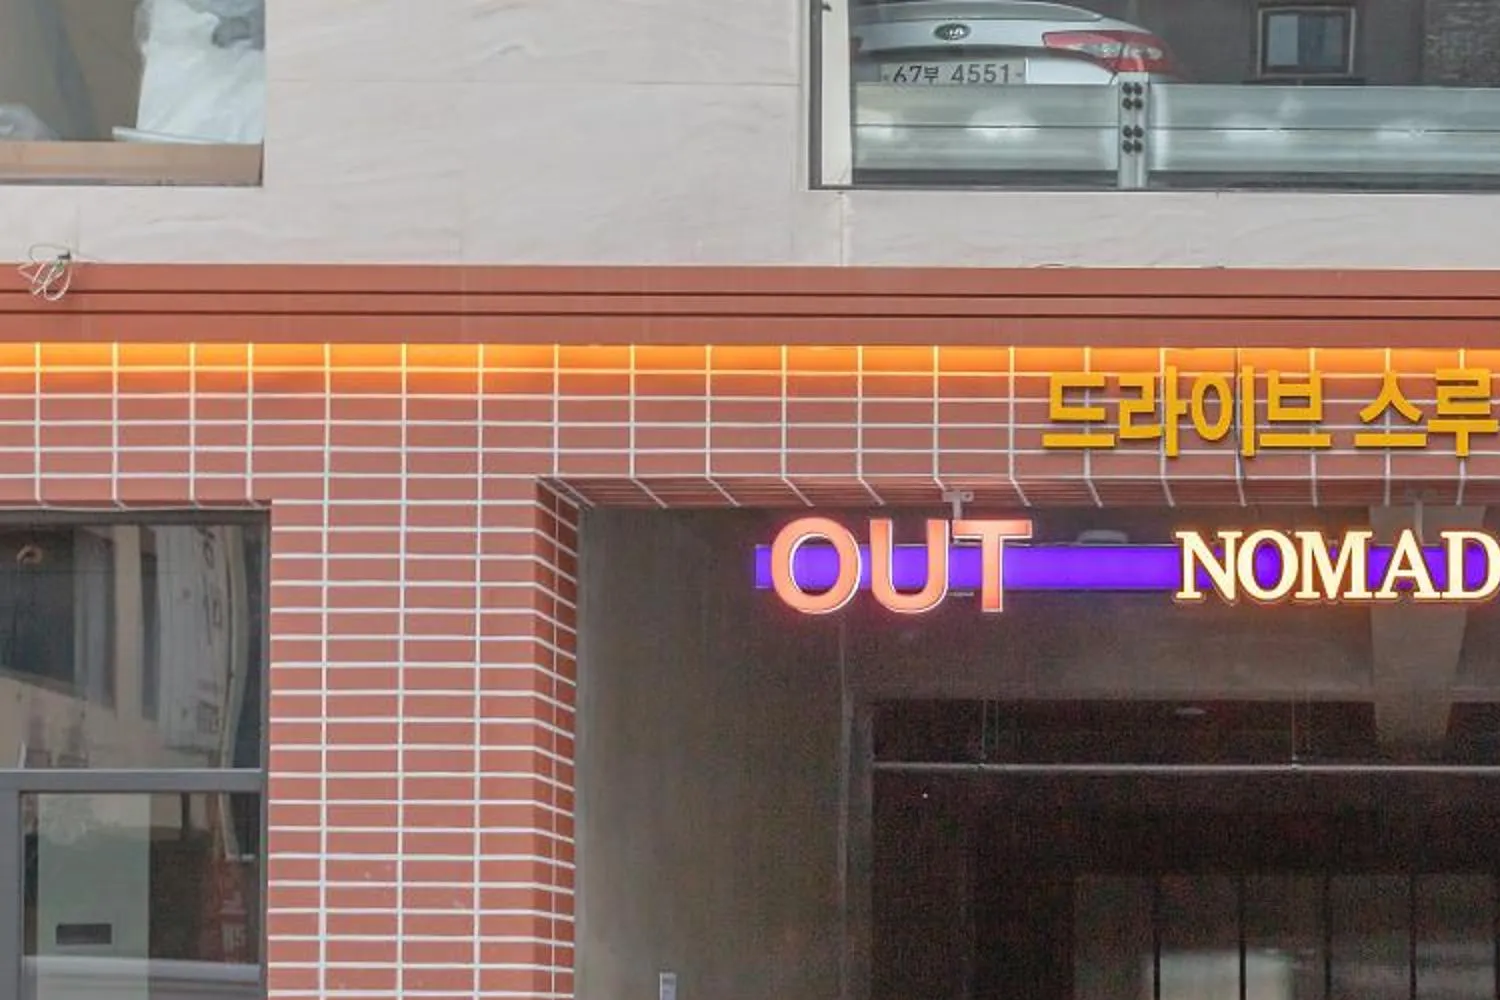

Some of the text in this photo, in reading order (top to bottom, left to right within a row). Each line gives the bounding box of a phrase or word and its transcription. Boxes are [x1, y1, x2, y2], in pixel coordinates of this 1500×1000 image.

[950, 63, 1010, 84] 4551
[1042, 365, 1332, 458] 드라이브
[1354, 367, 1499, 458] 스루
[769, 517, 1033, 614] OUT
